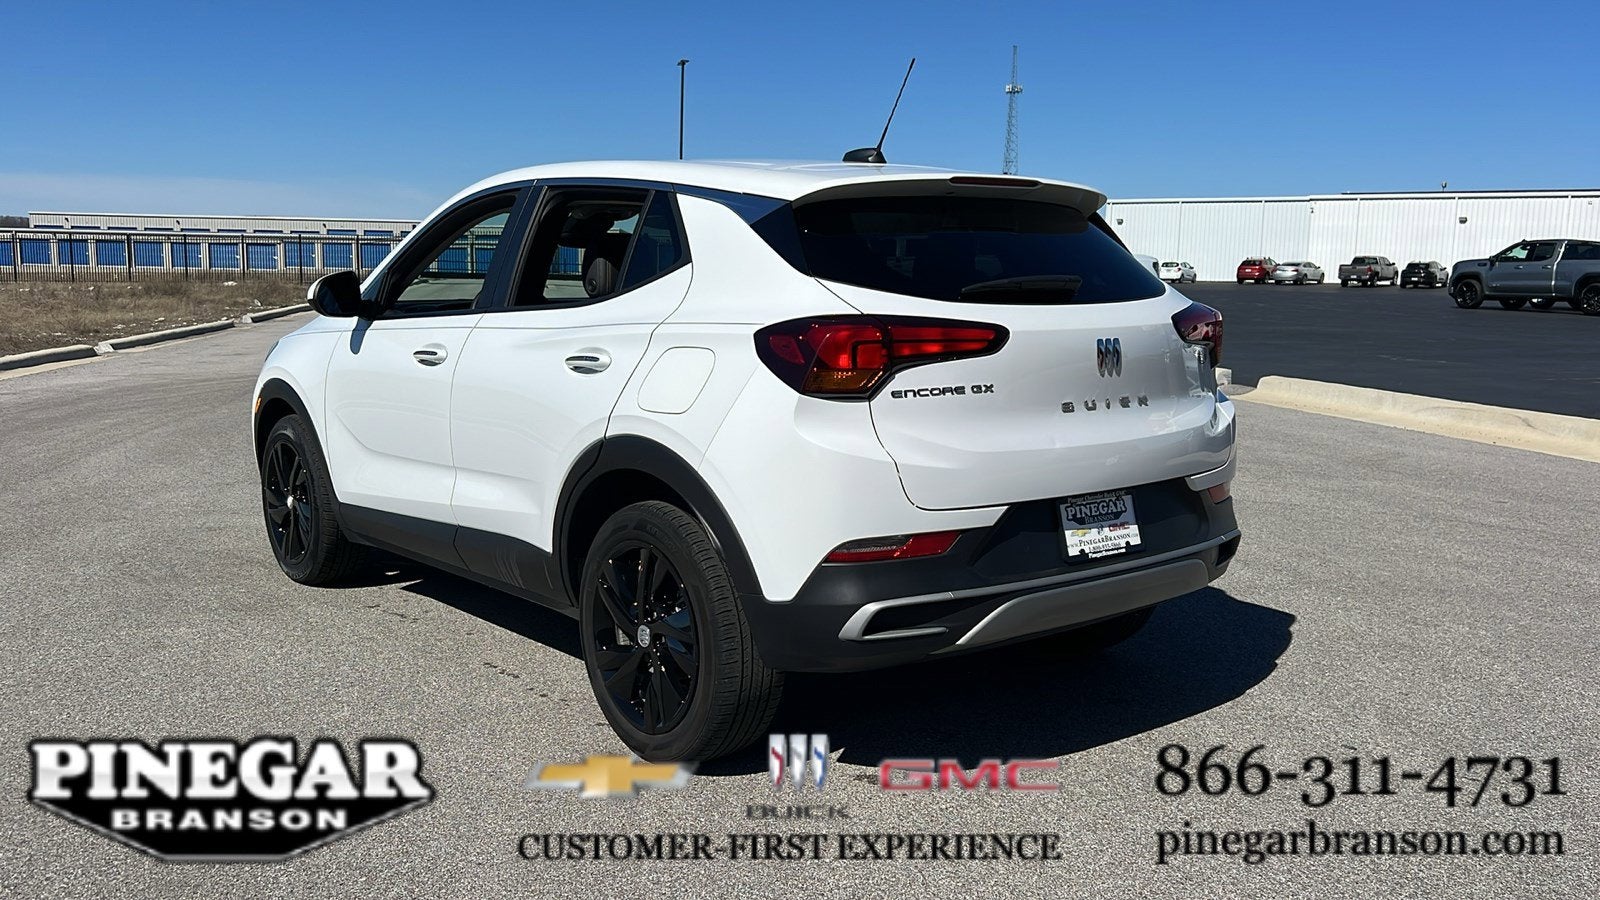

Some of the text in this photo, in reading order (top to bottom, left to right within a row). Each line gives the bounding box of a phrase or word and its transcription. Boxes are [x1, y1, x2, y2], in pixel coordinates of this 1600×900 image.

[891, 383, 996, 399] ENCORE GX
[1061, 394, 1149, 414] BUICK
[1066, 500, 1126, 519] PINEGAR
